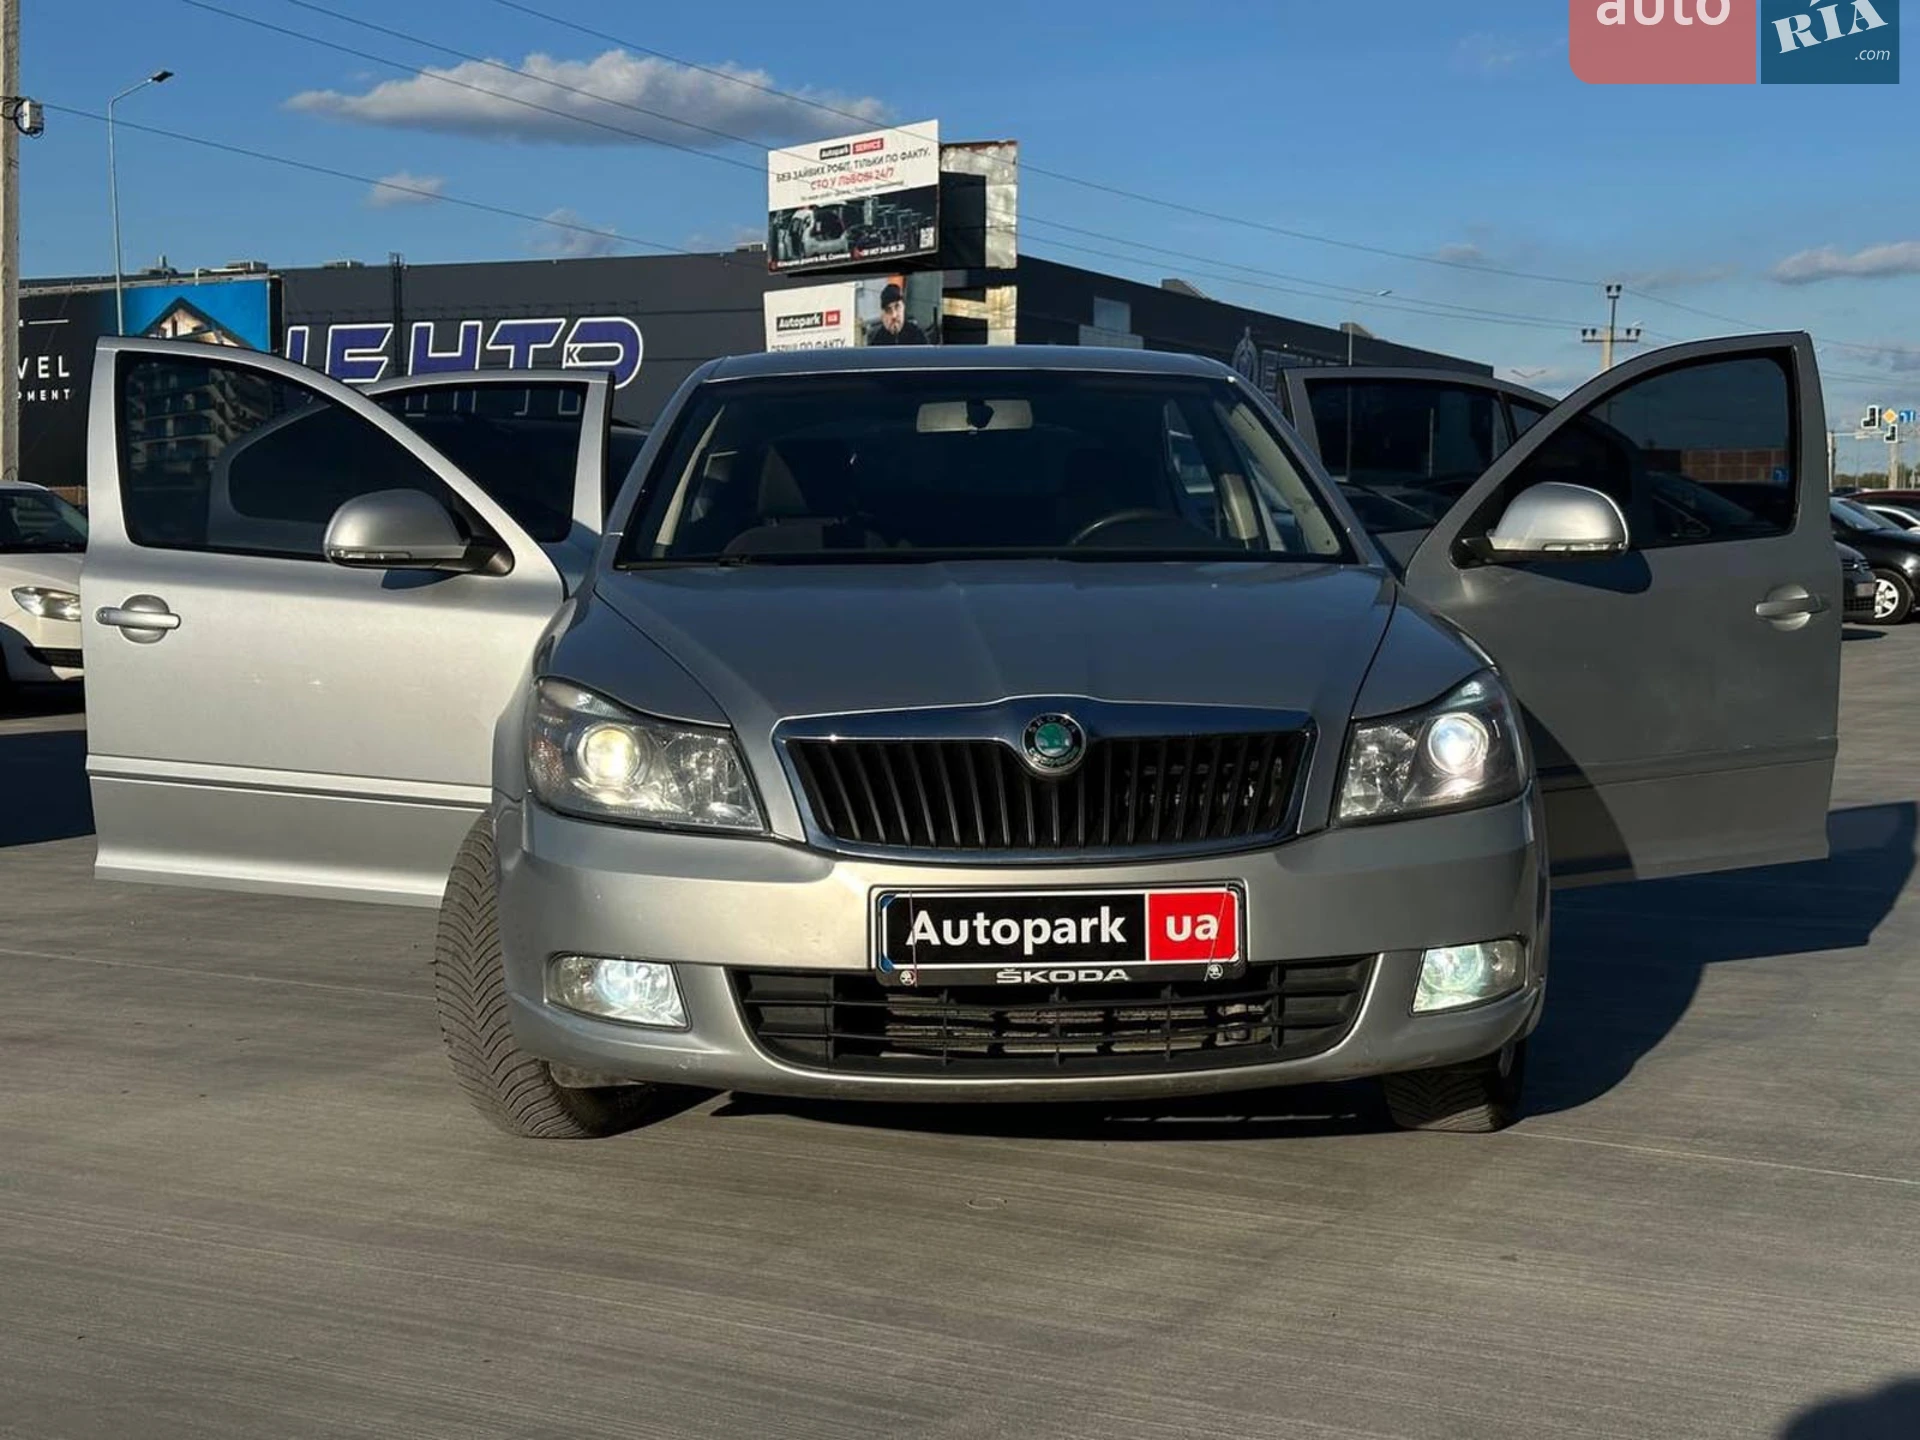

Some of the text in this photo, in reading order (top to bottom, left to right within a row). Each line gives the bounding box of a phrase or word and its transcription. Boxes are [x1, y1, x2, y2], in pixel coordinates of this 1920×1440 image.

[885, 153, 899, 164] ПО
[810, 179, 829, 191] СТО
[778, 312, 821, 329] Autopark
[905, 906, 1220, 956] Autopark ua
[996, 967, 1132, 984] ŠKODA
